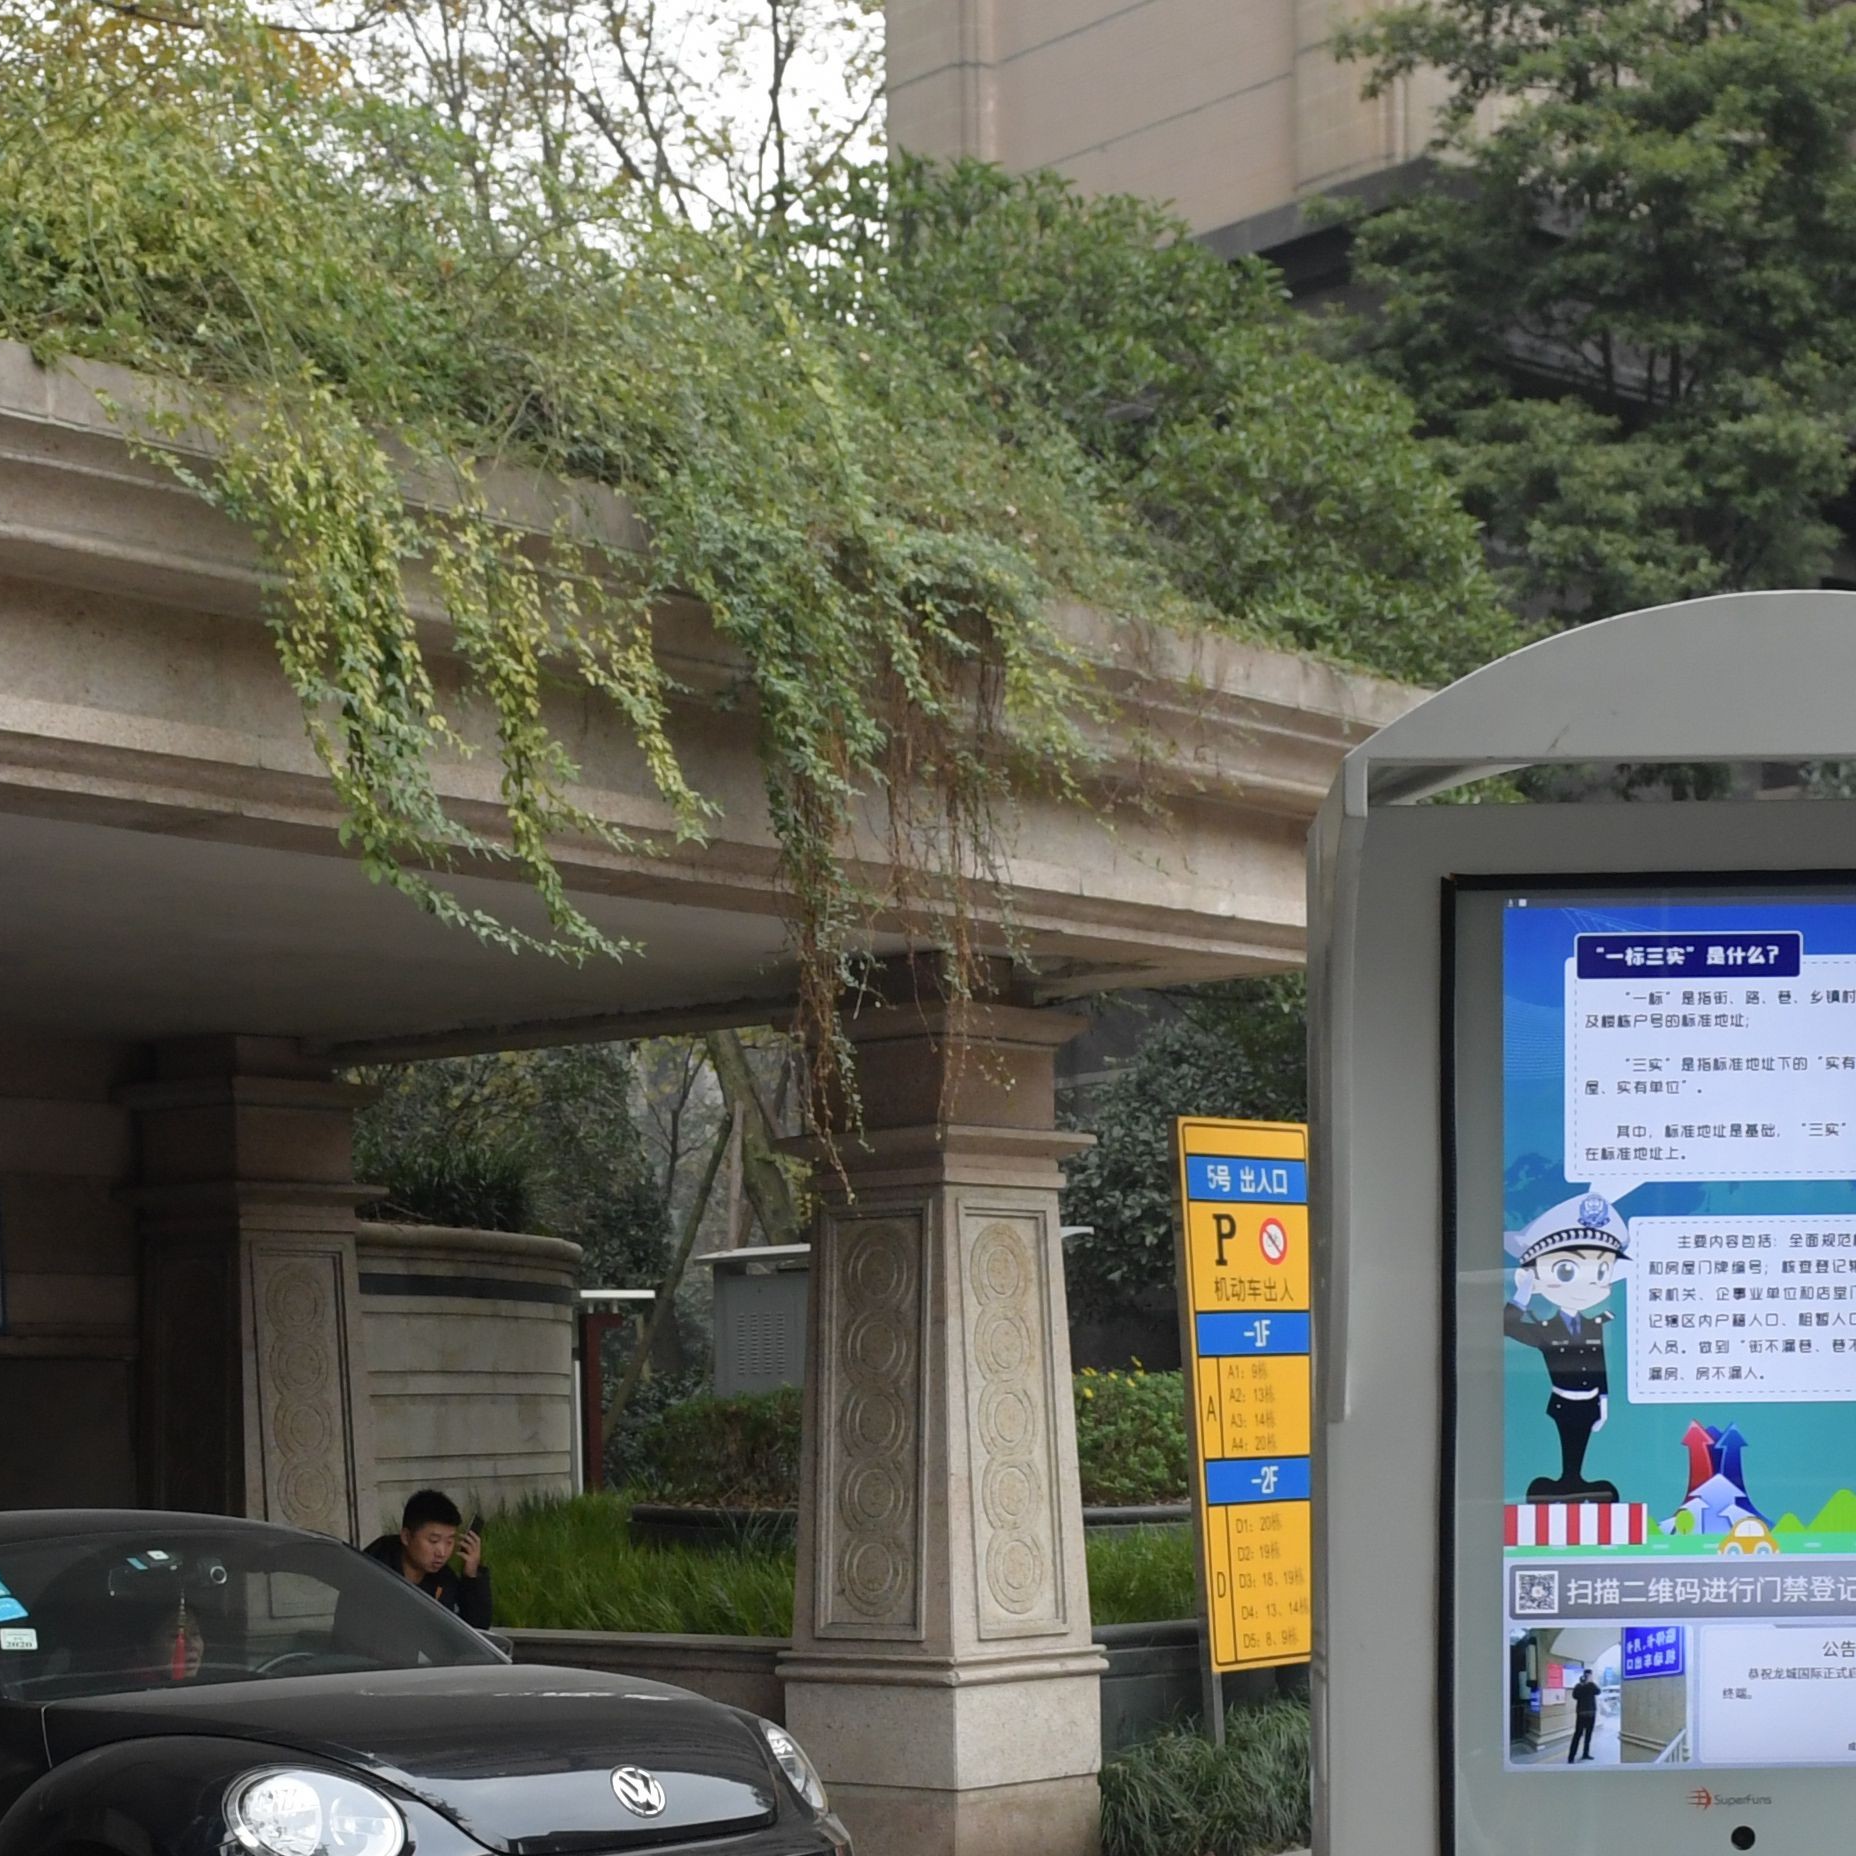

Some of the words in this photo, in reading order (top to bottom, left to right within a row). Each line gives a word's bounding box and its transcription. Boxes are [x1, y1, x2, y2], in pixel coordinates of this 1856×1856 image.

[1585, 1146, 1687, 1162] 在标准地址上。
[1207, 1165, 1231, 1193] 5号
[1239, 1166, 1288, 1194] 出入口
[1212, 1213, 1237, 1266] P
[1243, 1319, 1271, 1347] -1F
[1206, 1395, 1217, 1422] A
[1251, 1465, 1279, 1494] -2F
[1216, 1572, 1227, 1599] D
[1822, 1640, 1856, 1658] 公告
